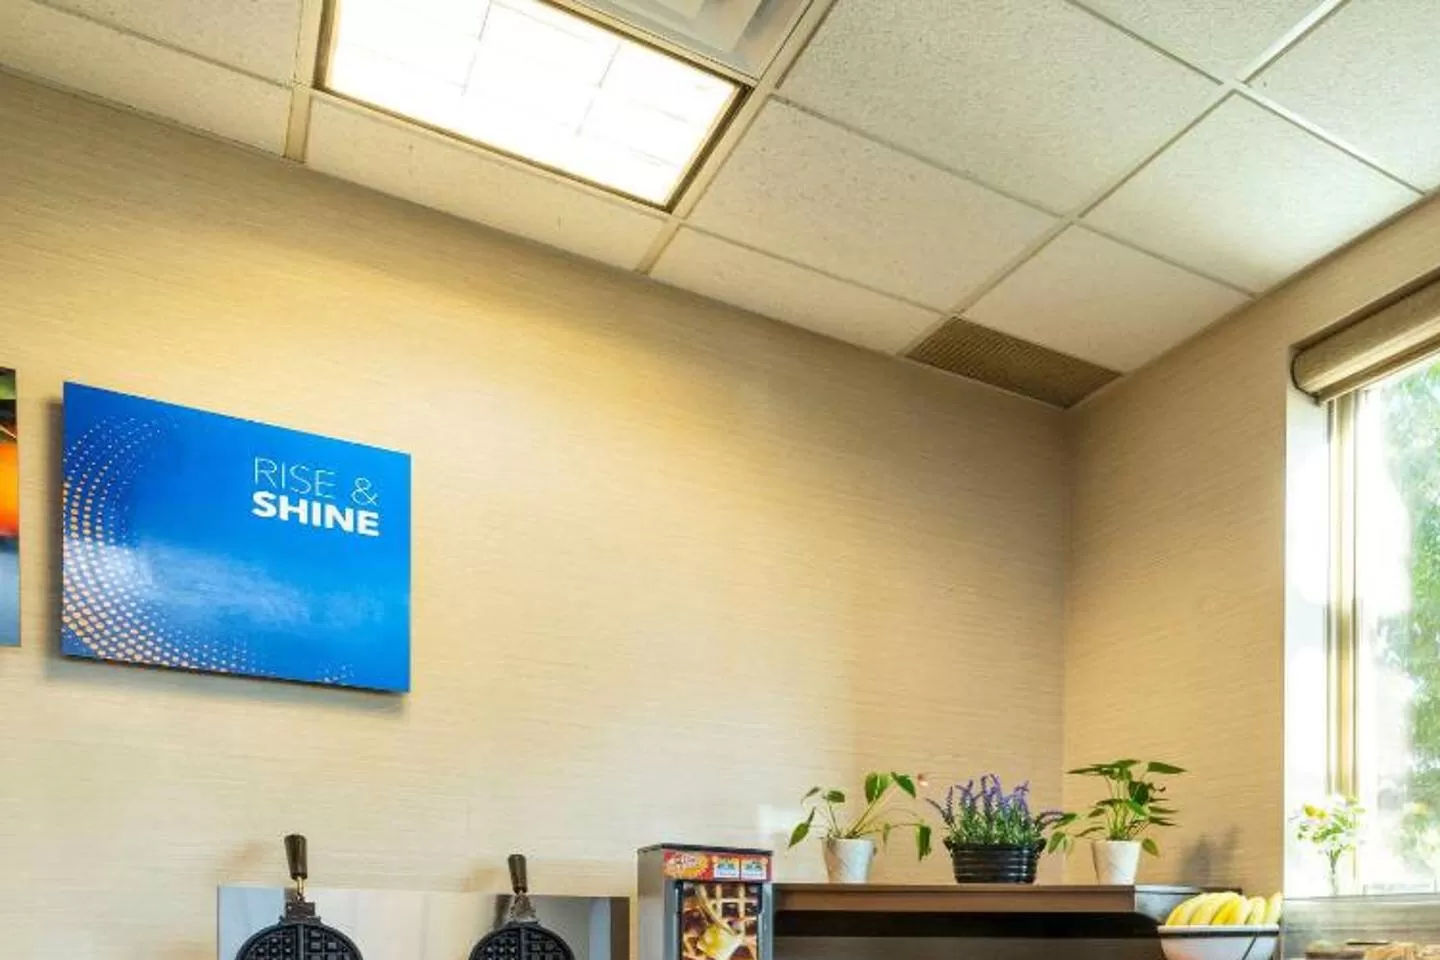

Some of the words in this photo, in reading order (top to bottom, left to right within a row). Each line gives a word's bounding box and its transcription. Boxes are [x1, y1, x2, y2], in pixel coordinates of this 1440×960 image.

[254, 456, 336, 499] RISE
[351, 477, 379, 506] &
[251, 490, 380, 537] SHINE
